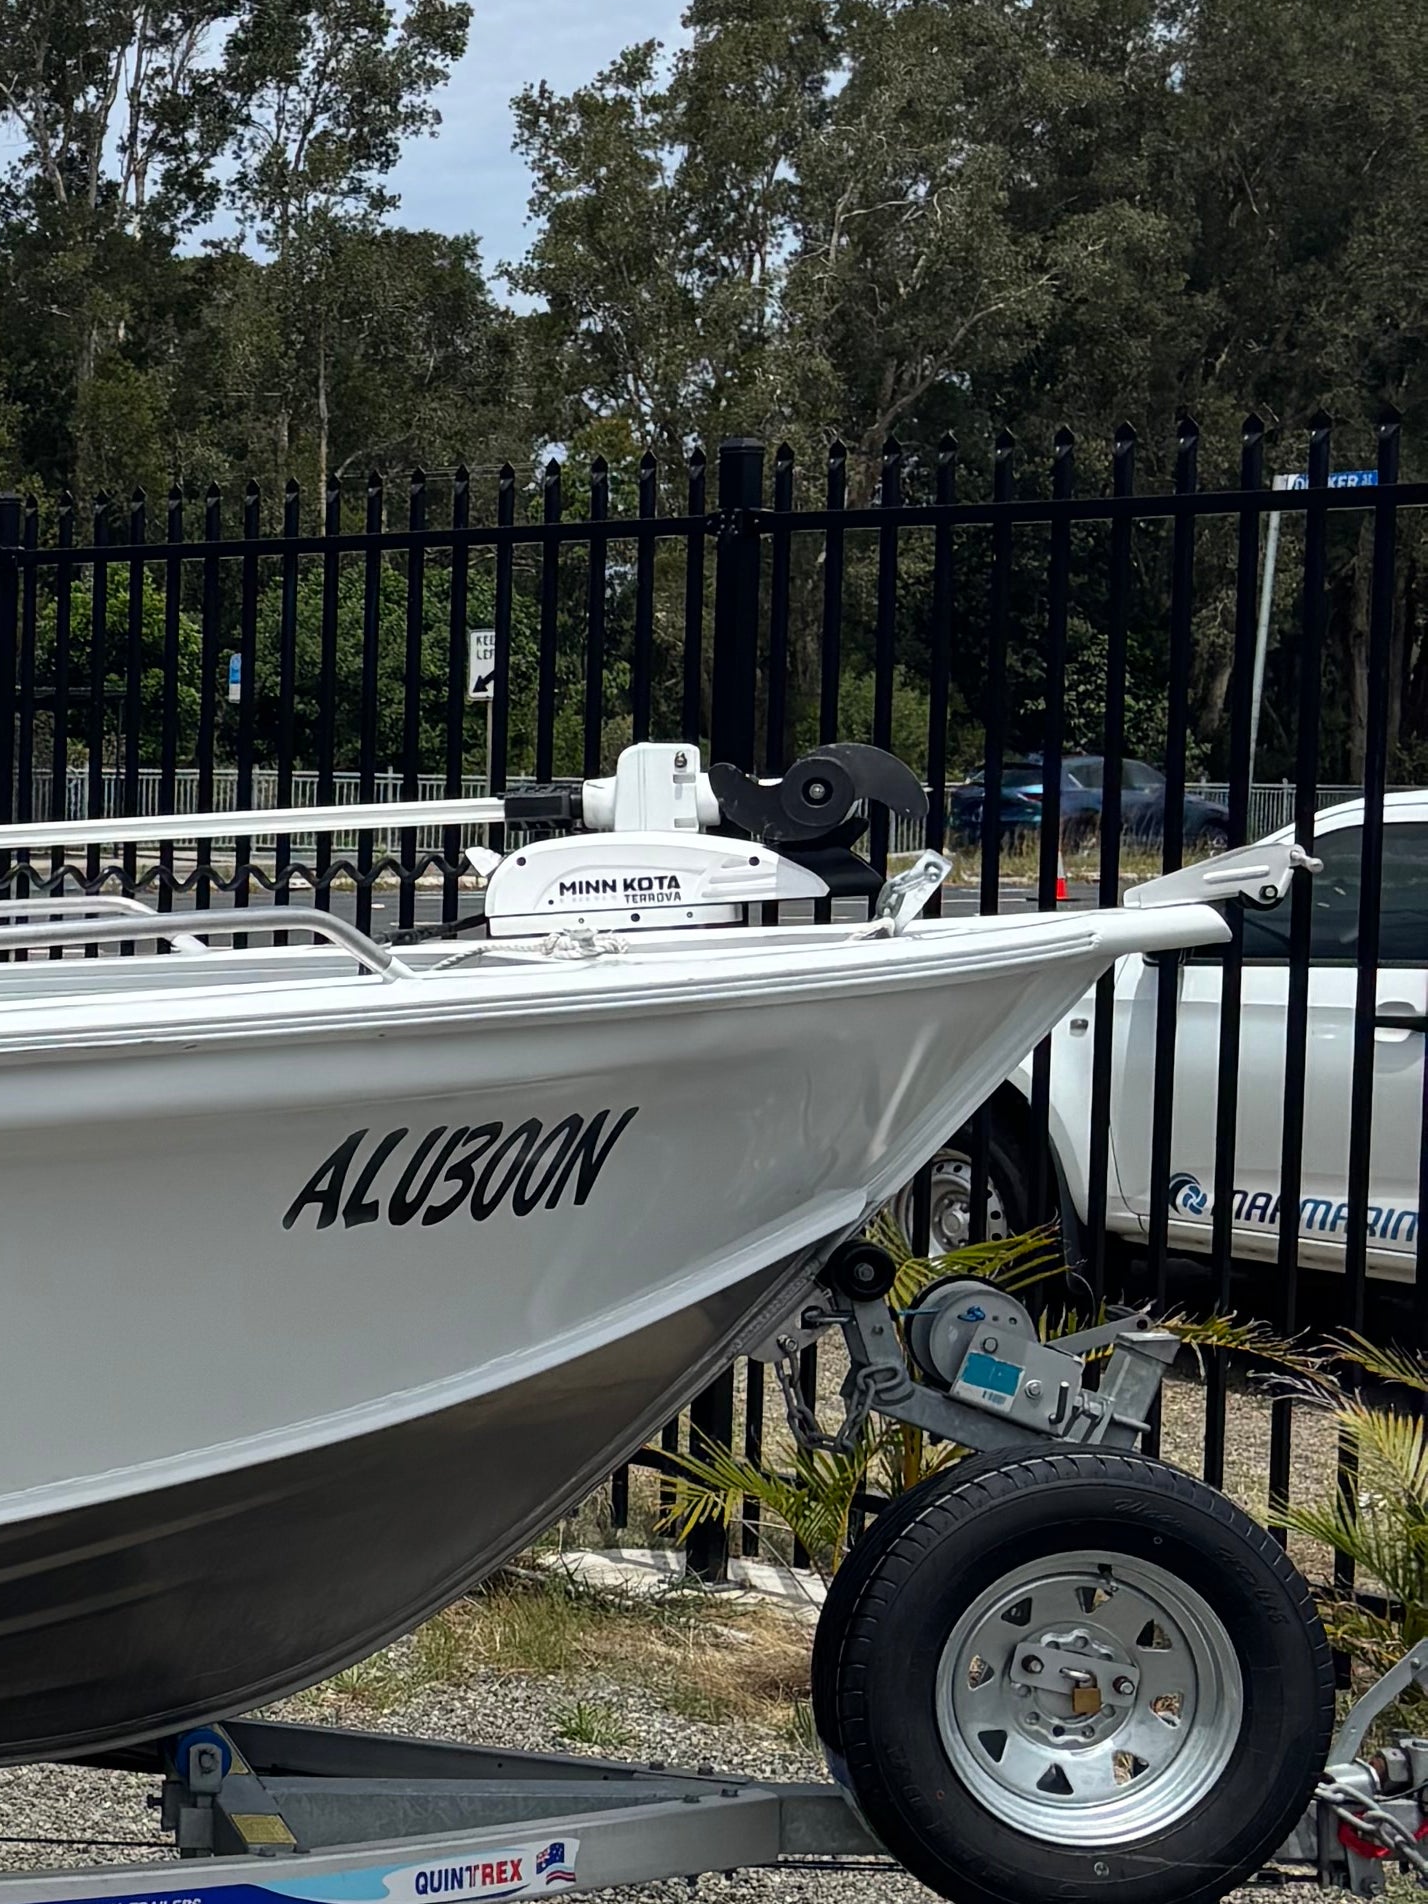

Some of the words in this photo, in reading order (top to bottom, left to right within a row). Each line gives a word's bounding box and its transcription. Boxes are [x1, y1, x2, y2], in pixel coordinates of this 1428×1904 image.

[476, 649, 495, 661] LEF
[559, 878, 617, 897] MINN
[623, 875, 681, 892] KOTA
[624, 891, 682, 905] TERROVA
[414, 1858, 524, 1895] QUINTREX
